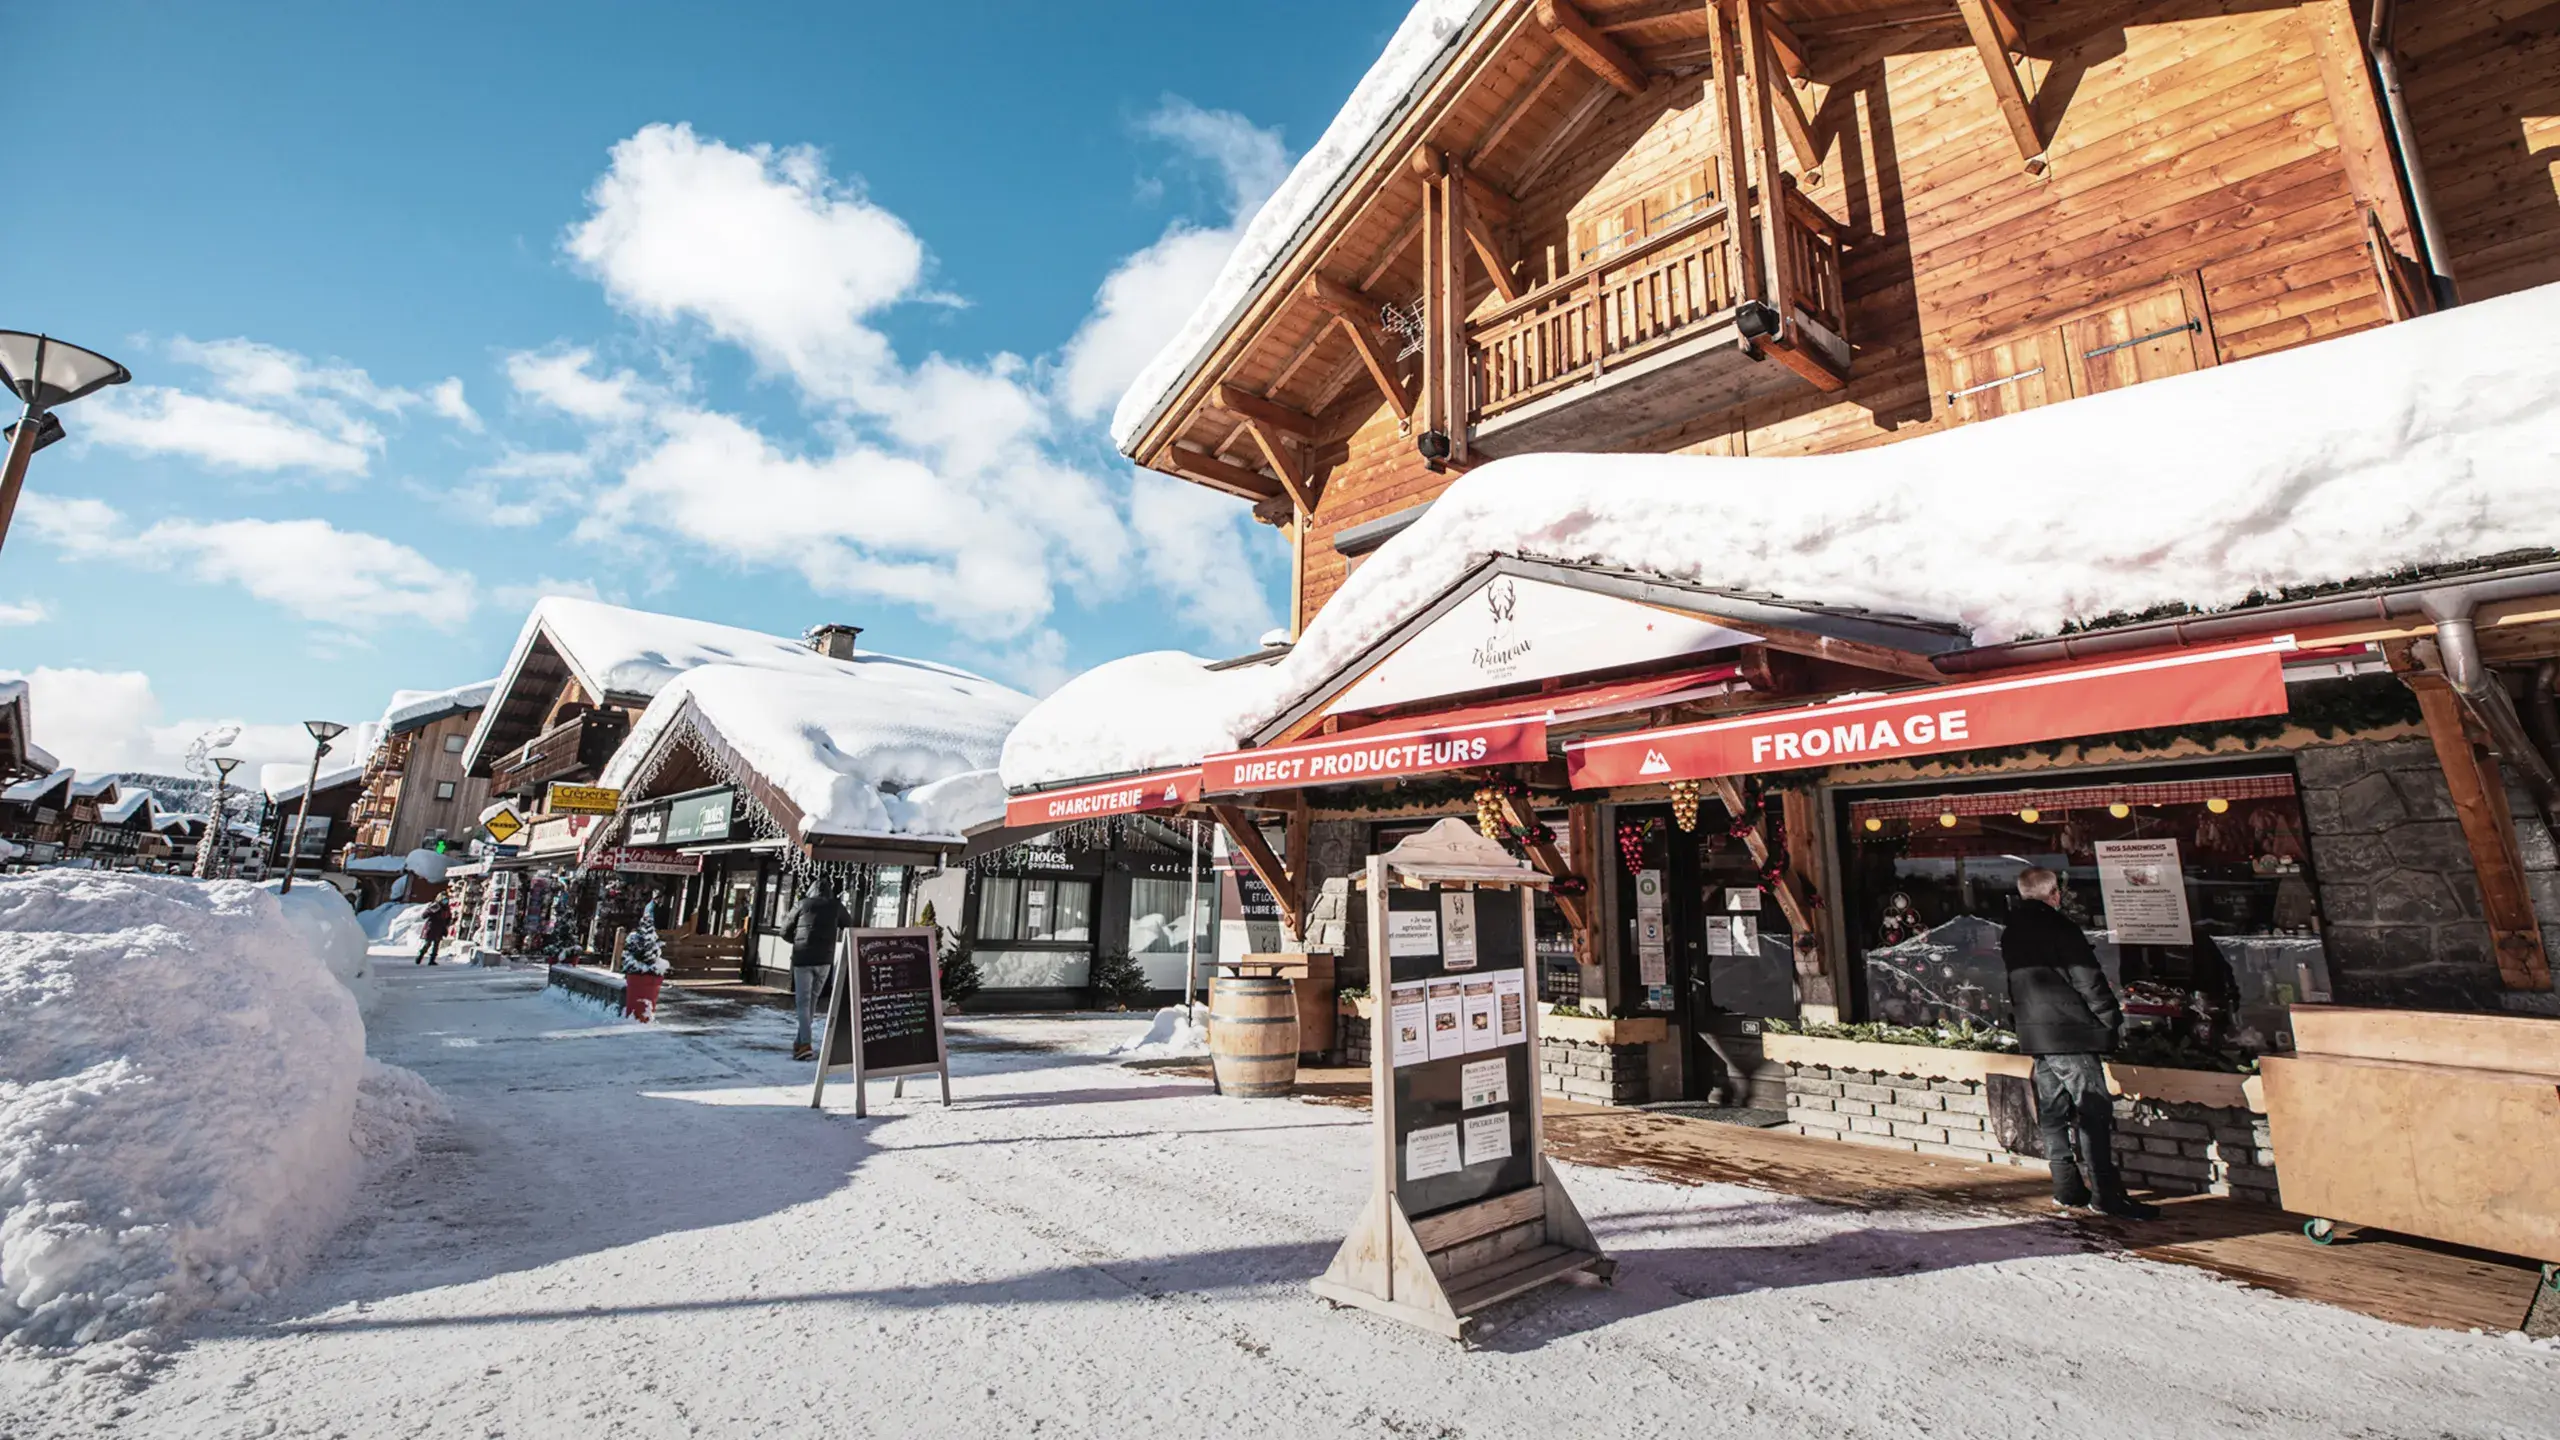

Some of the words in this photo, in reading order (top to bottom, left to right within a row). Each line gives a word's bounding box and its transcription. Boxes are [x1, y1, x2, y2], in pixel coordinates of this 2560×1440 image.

[1751, 709, 1969, 763] FROMAGE
[1234, 758, 1304, 784] DIRECT
[1309, 737, 1488, 776] PRODUCTEURS
[560, 786, 610, 800] Crêperie
[1049, 788, 1142, 816] CHARCUTERIE
[2105, 844, 2121, 852] NOS
[2122, 843, 2167, 852] SANDWICHS
[1029, 850, 1067, 863] notes
[1028, 862, 1074, 870] gourmandes
[1150, 862, 1178, 873] CAFÉ
[1252, 893, 1260, 902] ET
[1241, 905, 1251, 914] EN
[1252, 905, 1269, 914] LIBRE
